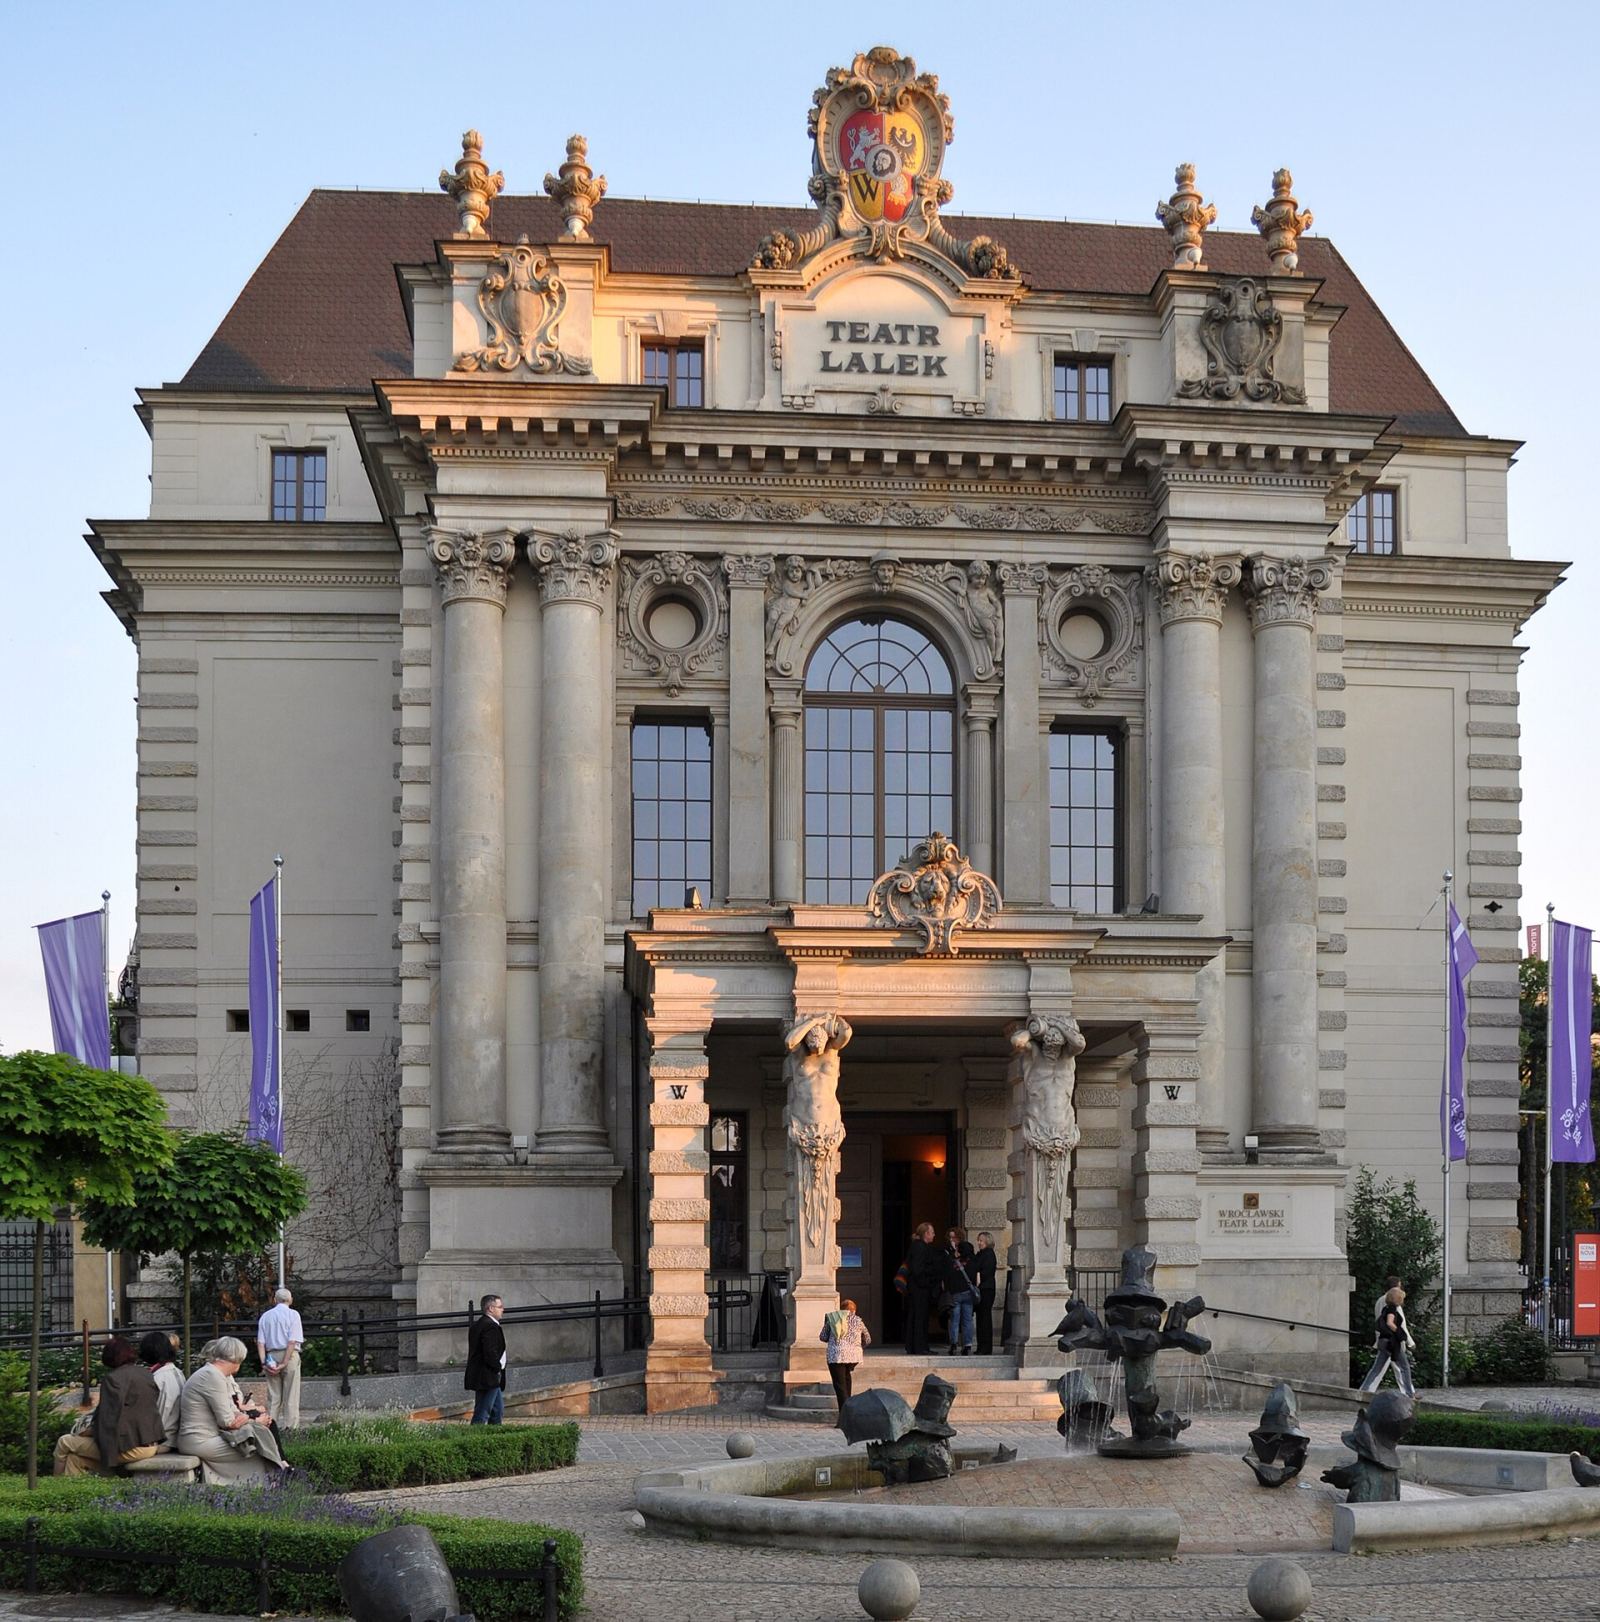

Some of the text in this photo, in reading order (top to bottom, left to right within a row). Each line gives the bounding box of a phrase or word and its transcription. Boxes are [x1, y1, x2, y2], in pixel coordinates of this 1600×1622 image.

[853, 174, 879, 203] W
[826, 321, 941, 346] TEATR
[820, 350, 948, 377] LALEK
[670, 1084, 688, 1099] W
[1163, 1085, 1181, 1100] W
[1218, 1209, 1285, 1218] WROCŁAWSKI
[1218, 1219, 1285, 1228] TEATR LALEK
